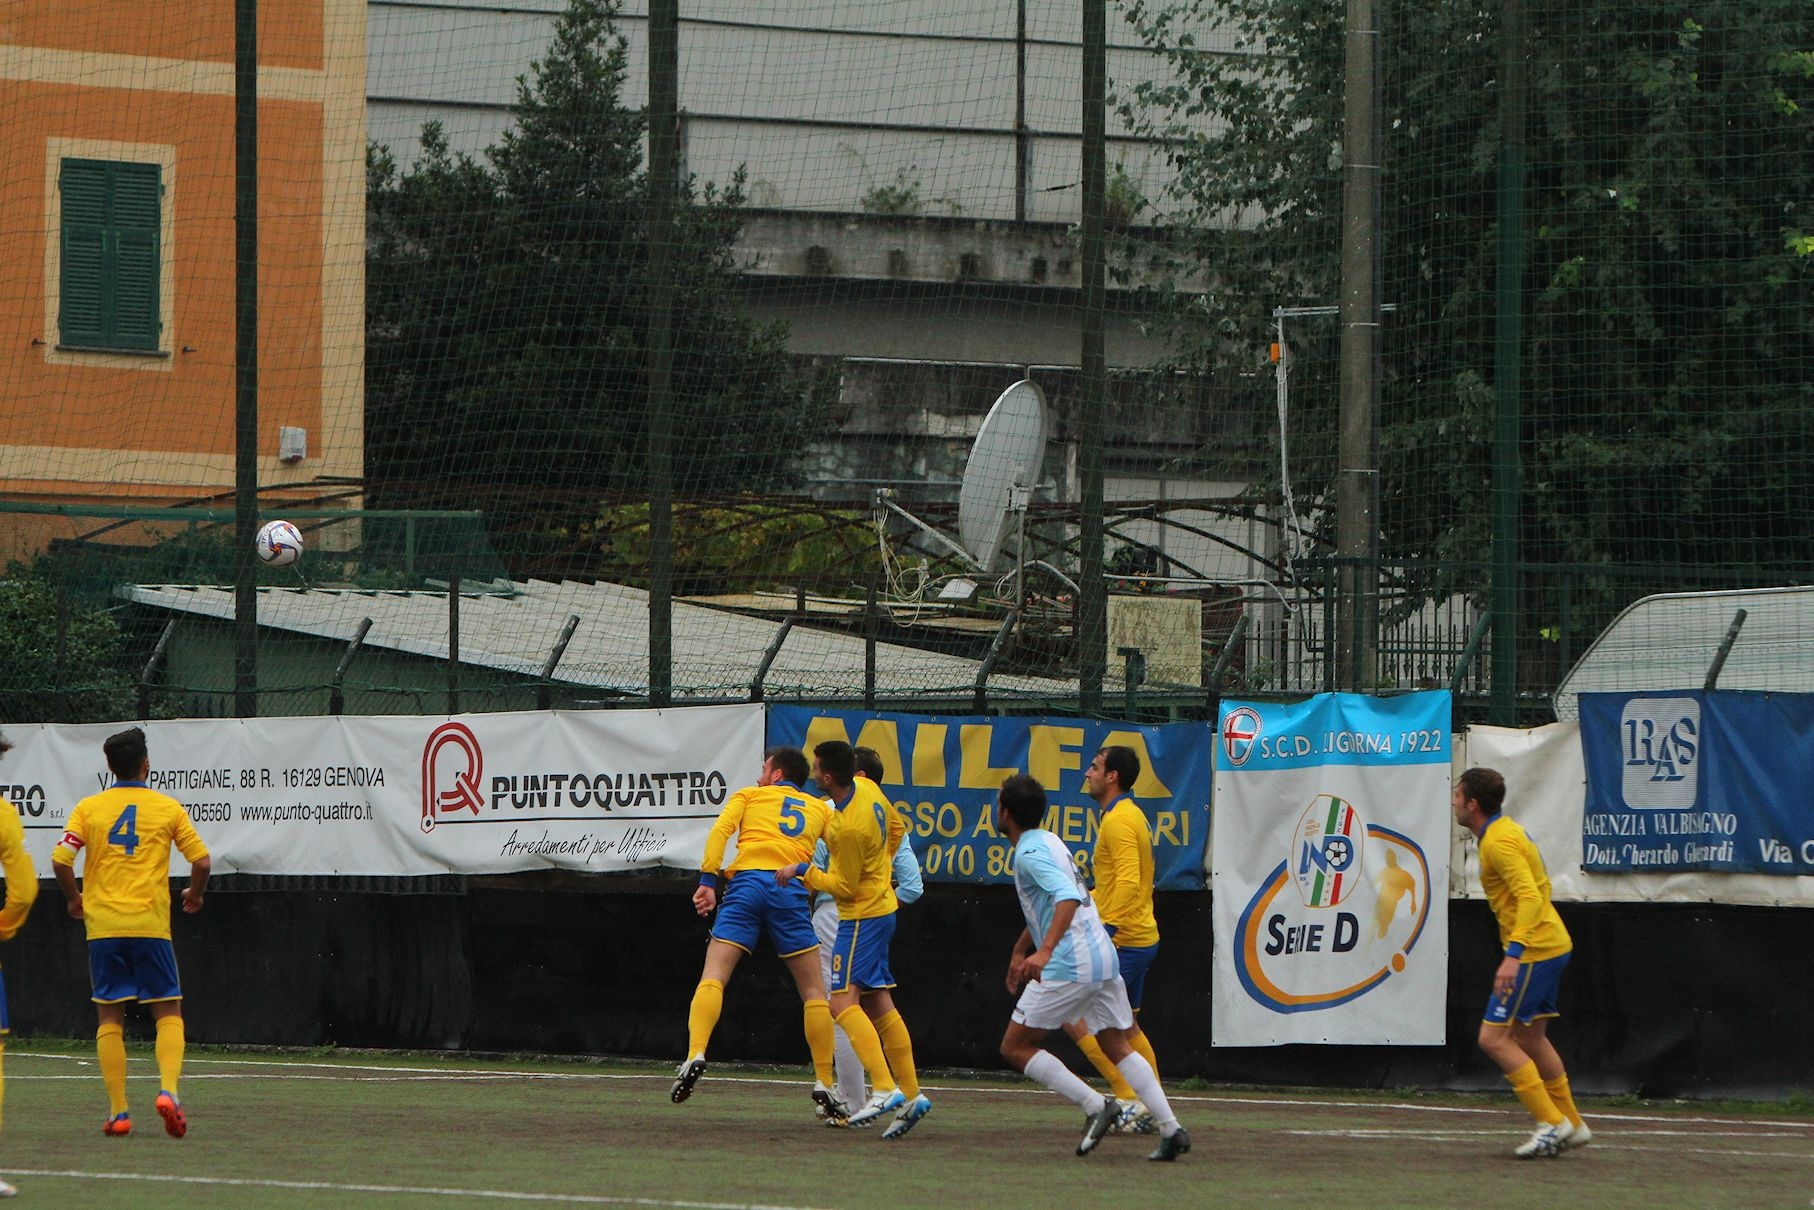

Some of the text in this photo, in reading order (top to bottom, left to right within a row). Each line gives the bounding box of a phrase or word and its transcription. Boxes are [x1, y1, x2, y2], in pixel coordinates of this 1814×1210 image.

[801, 716, 1174, 798] MILFA
[1400, 729, 1441, 753] 1922
[1624, 717, 1698, 782] RAS
[150, 769, 235, 791] PARTIGIANE,
[240, 769, 256, 788] 88
[261, 769, 275, 788] R.
[283, 768, 322, 787] 16129
[325, 767, 385, 787] GENOVA
[491, 771, 727, 811] PUNTOQUATTRO
[108, 804, 139, 856] 4
[180, 801, 373, 825] 705560 www.punto-quattro.it
[778, 796, 806, 837] 5
[1583, 813, 1646, 836] AGENZIA
[501, 827, 667, 865] Arredamenti per Ufficio
[1586, 843, 1621, 865] Dott.
[1759, 838, 1793, 864] Via
[1332, 912, 1359, 953] D
